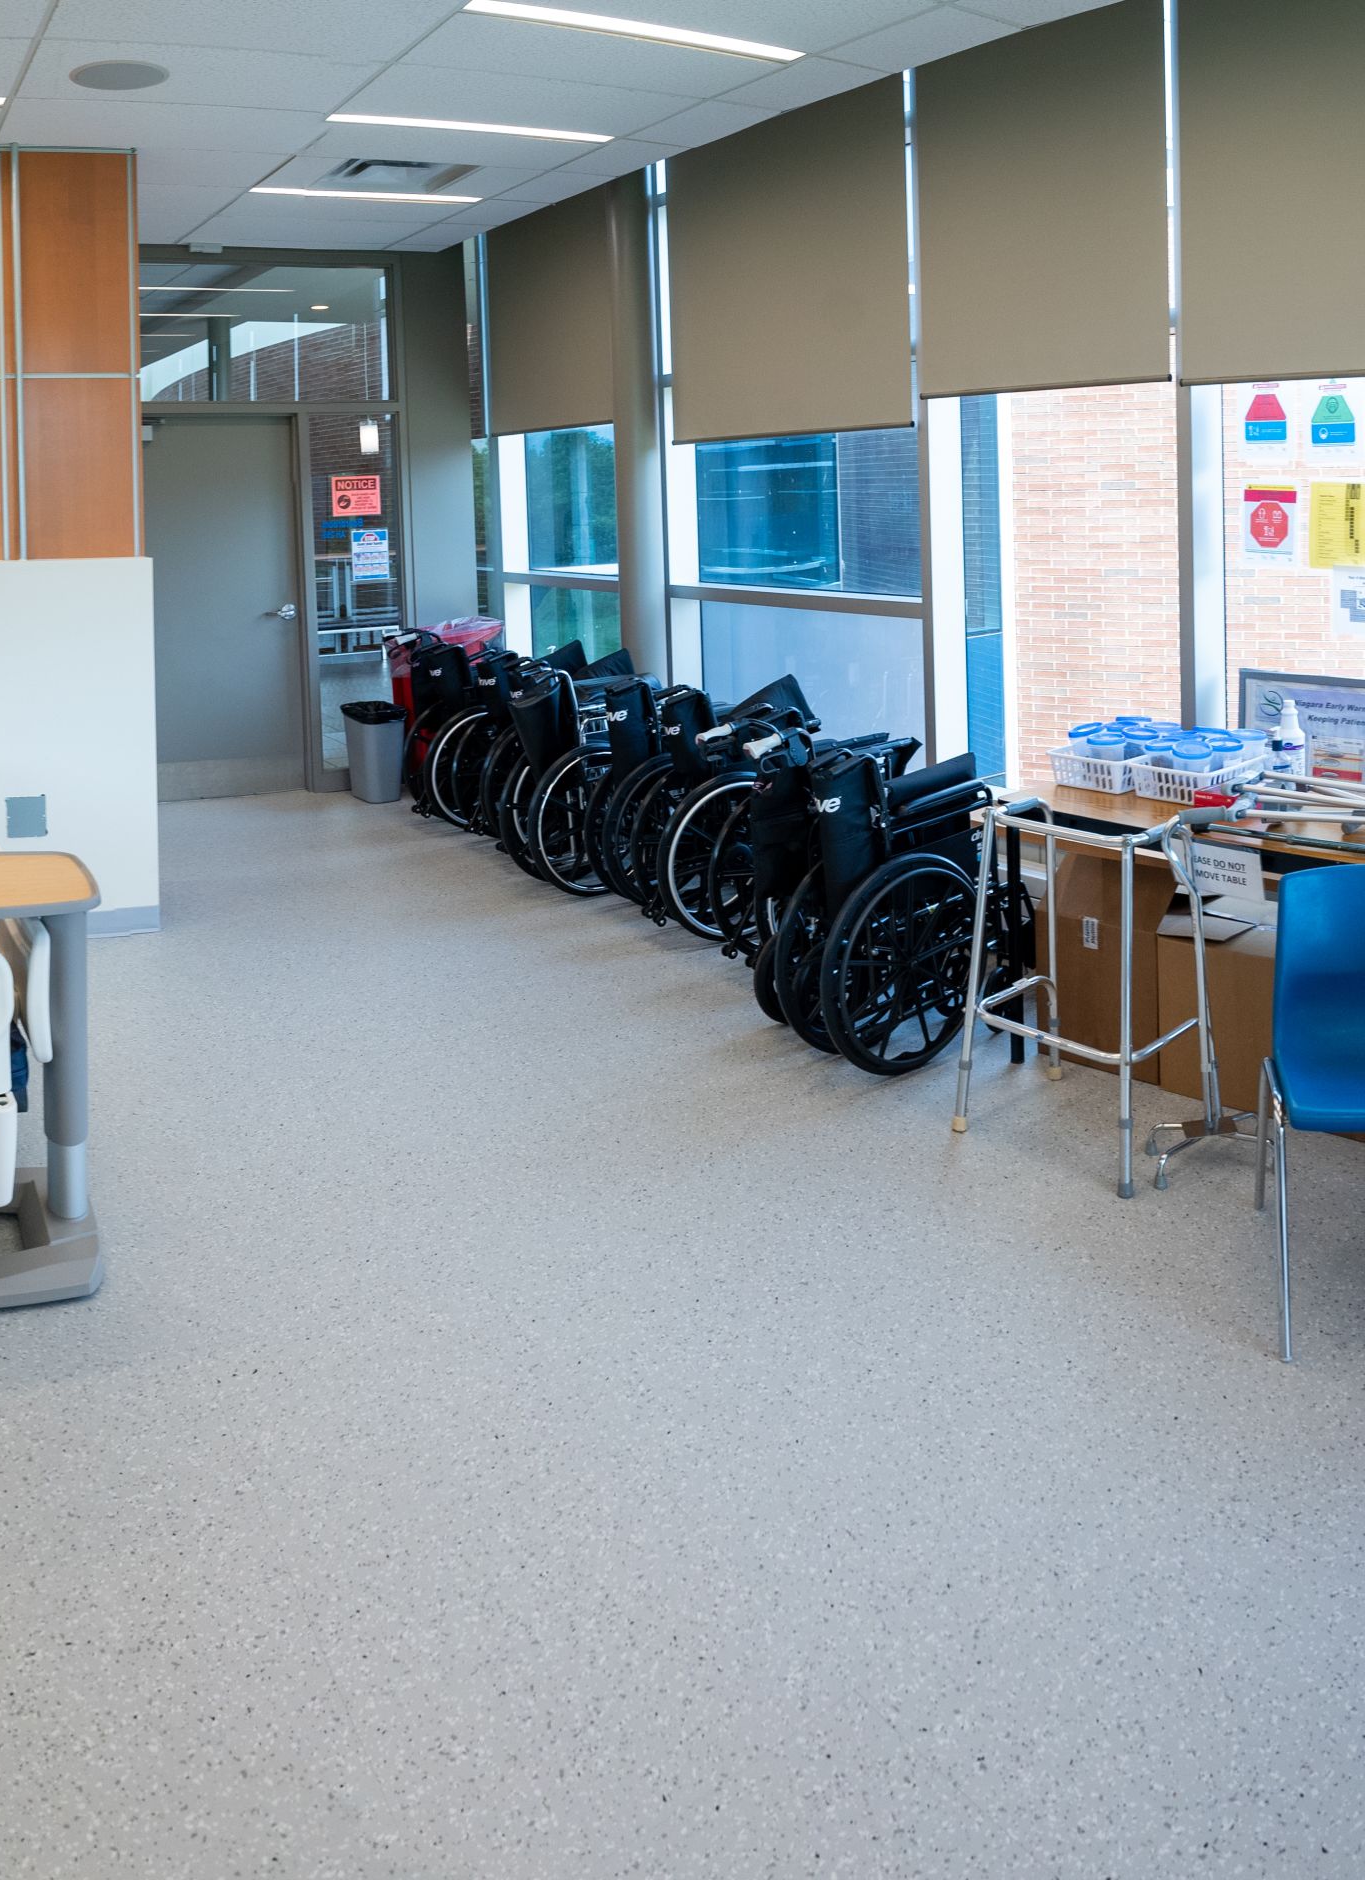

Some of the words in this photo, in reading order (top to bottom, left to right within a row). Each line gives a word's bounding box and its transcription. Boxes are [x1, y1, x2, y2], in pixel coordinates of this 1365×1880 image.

[337, 480, 375, 490] NOTICE
[478, 677, 496, 686] rive
[1325, 702, 1345, 711] Early
[1307, 714, 1339, 725] Keeping
[1193, 855, 1211, 866] EASE
[1213, 859, 1226, 868] DO
[1228, 862, 1245, 871] NOT
[1195, 869, 1219, 881] MOVE
[1221, 874, 1247, 886] TABLE
